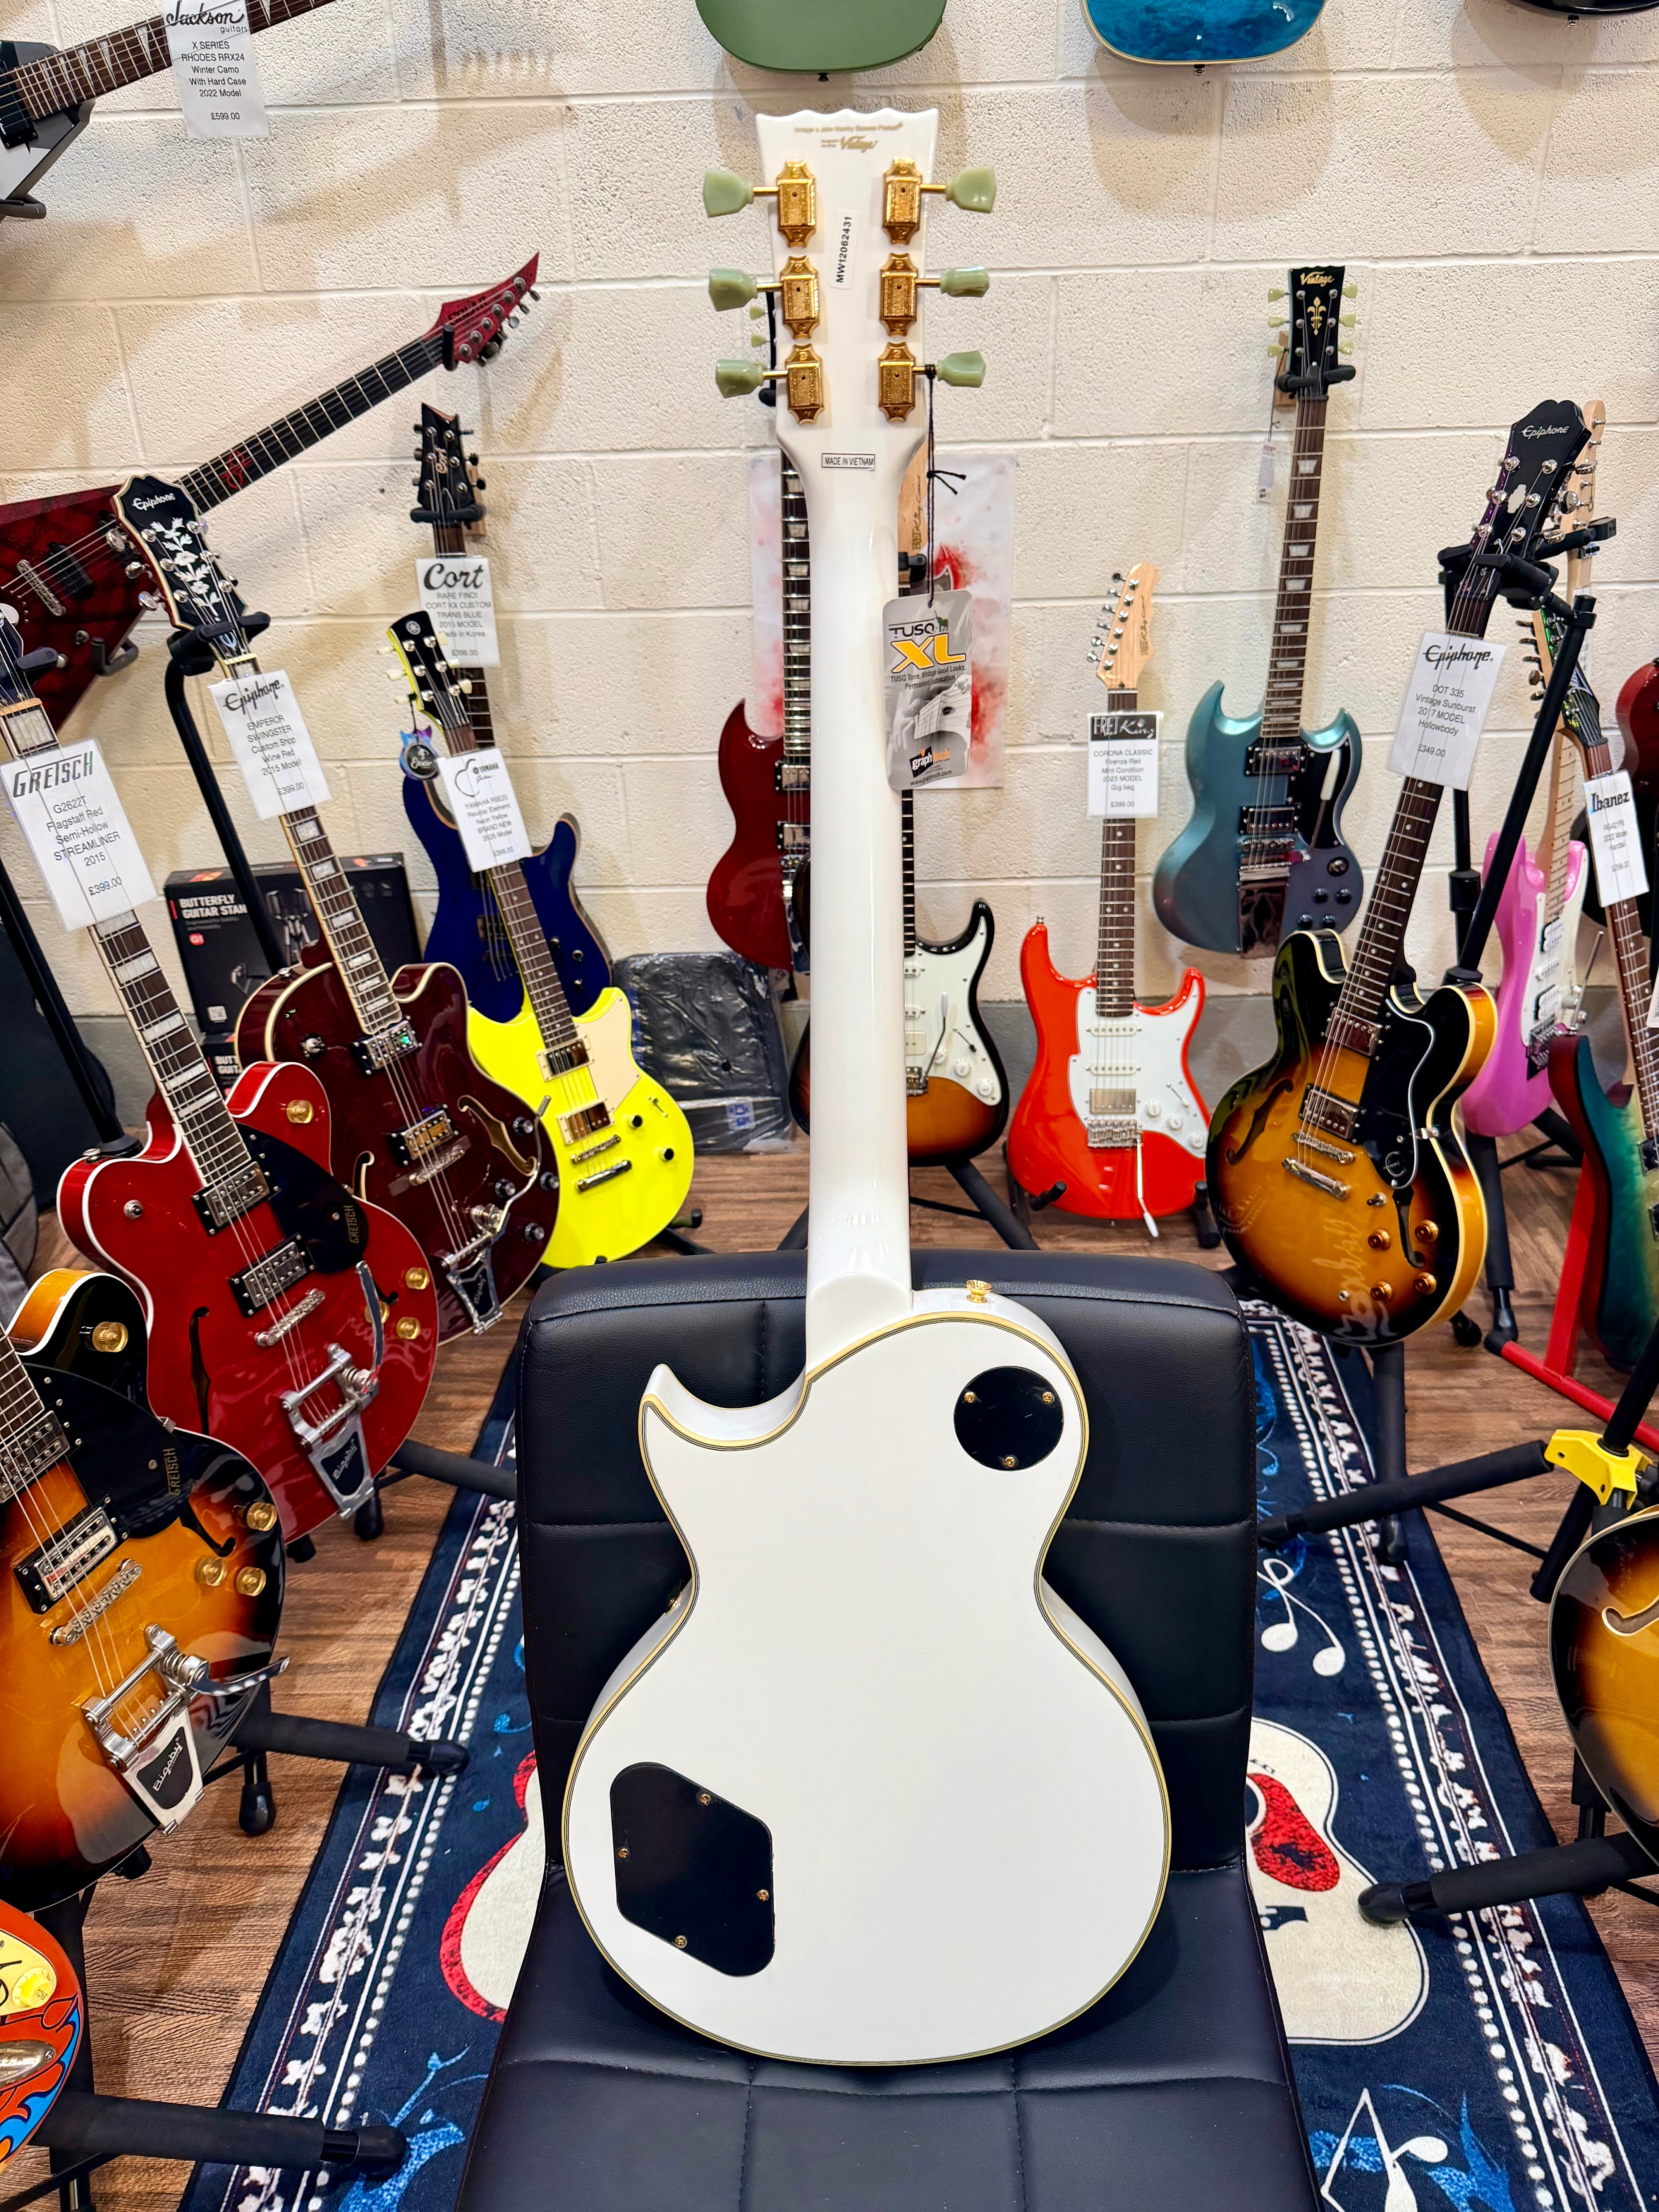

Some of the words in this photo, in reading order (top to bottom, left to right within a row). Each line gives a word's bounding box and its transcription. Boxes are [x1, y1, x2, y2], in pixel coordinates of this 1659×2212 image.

[166, 0, 245, 26] Jackson
[200, 41, 230, 49] SERIES
[181, 53, 216, 61] RHODES
[218, 53, 245, 61] RRX24
[836, 216, 852, 283] MW12062431
[1300, 271, 1334, 287] Vintage
[1522, 425, 1570, 440] Epiphone
[825, 457, 841, 465] MADE
[132, 493, 175, 511] Epiphone
[424, 563, 483, 591] Cort
[891, 633, 967, 674] XL
[890, 675, 906, 683] TUSQ
[922, 670, 937, 678] Vintage
[905, 680, 930, 690] Permanent
[1432, 684, 1449, 694] DOT
[1449, 687, 1465, 698] 335
[1416, 694, 1441, 707] Vintage
[1442, 699, 1476, 713] Sunburst
[247, 715, 285, 730] EMPEROR
[1436, 709, 1465, 724] MODEL
[247, 725, 292, 742] SWINGSTER
[1093, 716, 1121, 737] FRET
[1418, 719, 1458, 737] Hollowbody
[251, 741, 280, 754] Custom
[280, 737, 296, 747] Shop
[1418, 744, 1446, 757] £349.00
[262, 752, 281, 763] Wine
[281, 749, 295, 759] Red
[13, 751, 93, 798] GRETSCH
[479, 763, 499, 773] YAMAHA
[278, 781, 304, 795] £399.00
[53, 796, 87, 813] G2622T
[1590, 791, 1630, 812] Ibanez
[46, 811, 85, 832] Flagstaff
[86, 806, 103, 819] Red
[55, 821, 108, 845] Semi-Hollow
[54, 831, 121, 861] STREAMLINER
[84, 852, 106, 867] 2015
[89, 876, 122, 896] £399.00
[179, 894, 235, 908] BUTTERFLY
[182, 907, 220, 919] GUITAR
[220, 903, 248, 915] STAN
[343, 1205, 359, 1244] GRETSCH
[162, 1448, 181, 1497] GRETSCH
[153, 1742, 183, 1791] Bigsby
